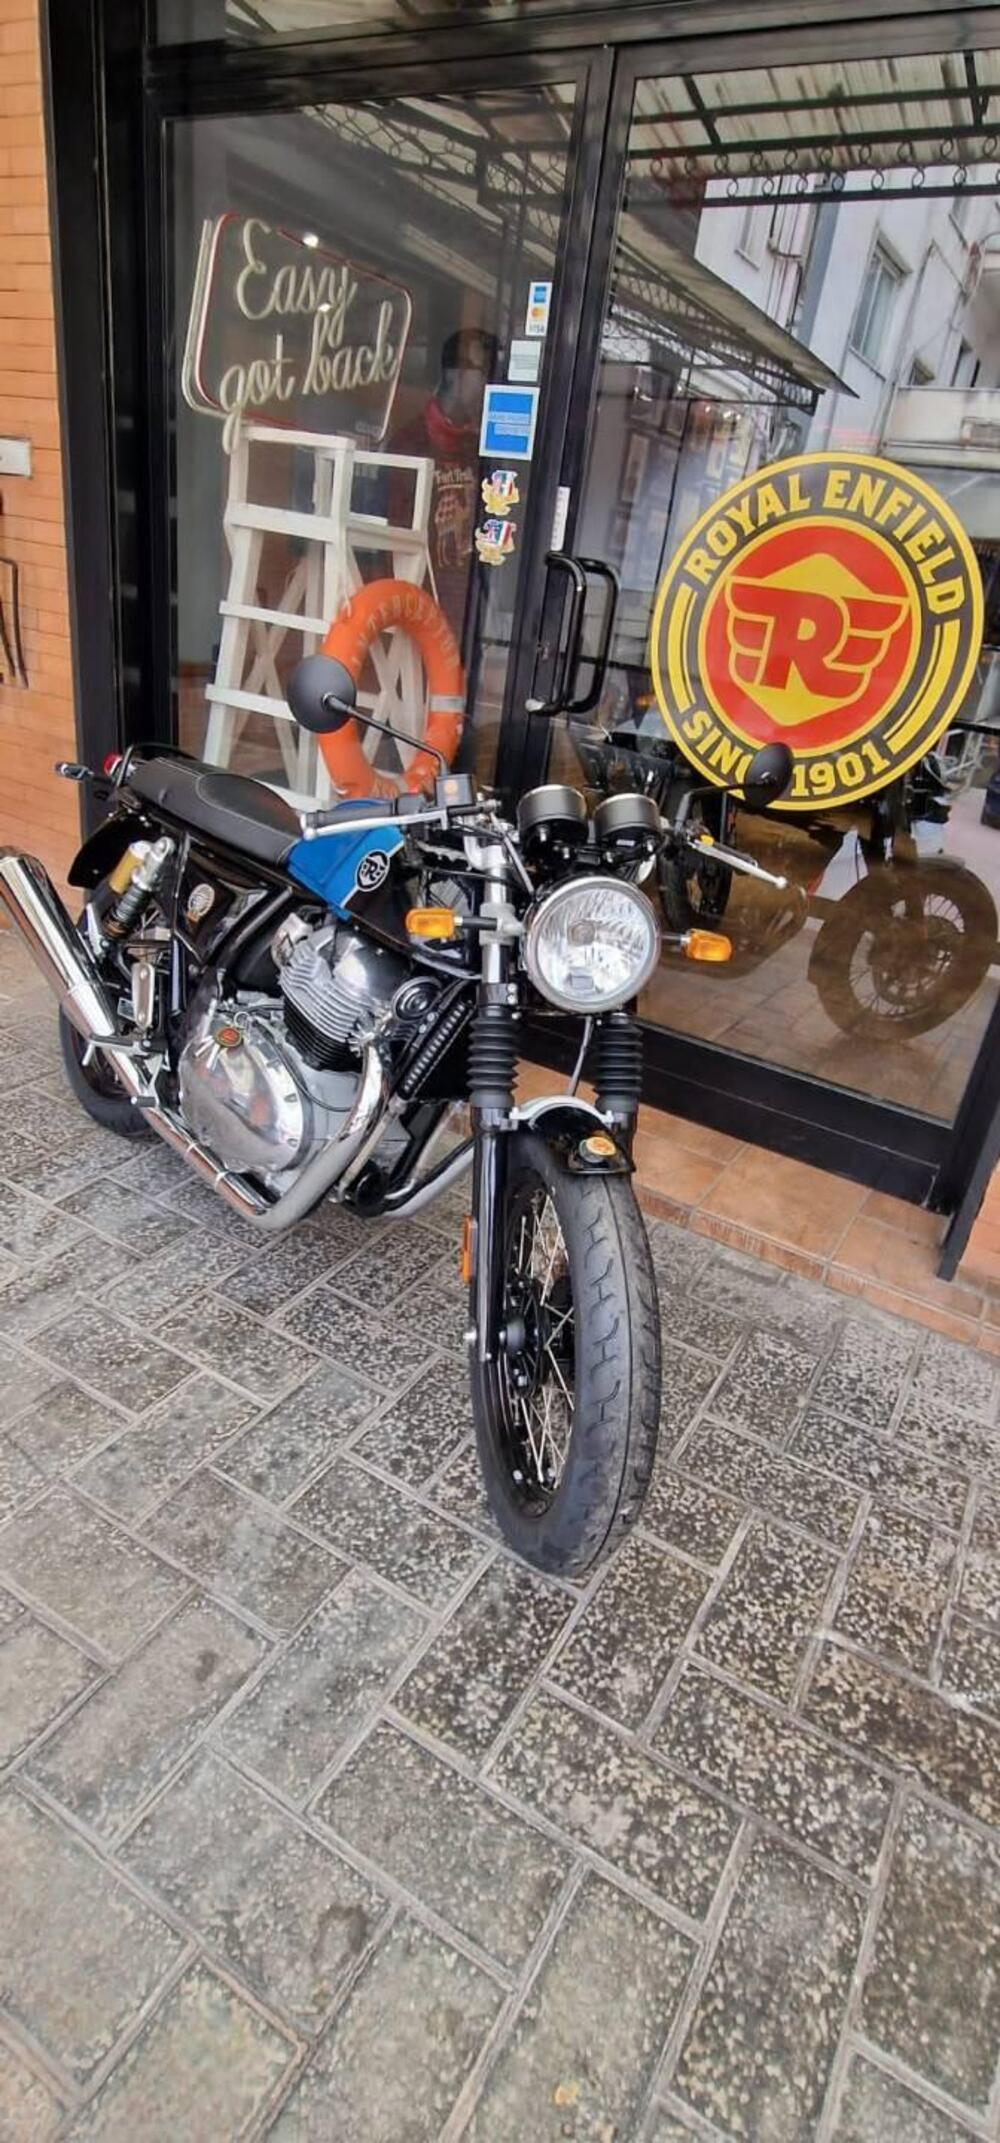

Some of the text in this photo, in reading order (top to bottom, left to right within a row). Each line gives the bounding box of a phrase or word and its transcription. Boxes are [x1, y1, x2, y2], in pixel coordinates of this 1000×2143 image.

[236, 218, 358, 348] Easy
[219, 300, 398, 455] got back
[684, 473, 811, 585] ROYAL
[822, 469, 966, 615] ENFIELD
[682, 710, 891, 797] SIN 1901
